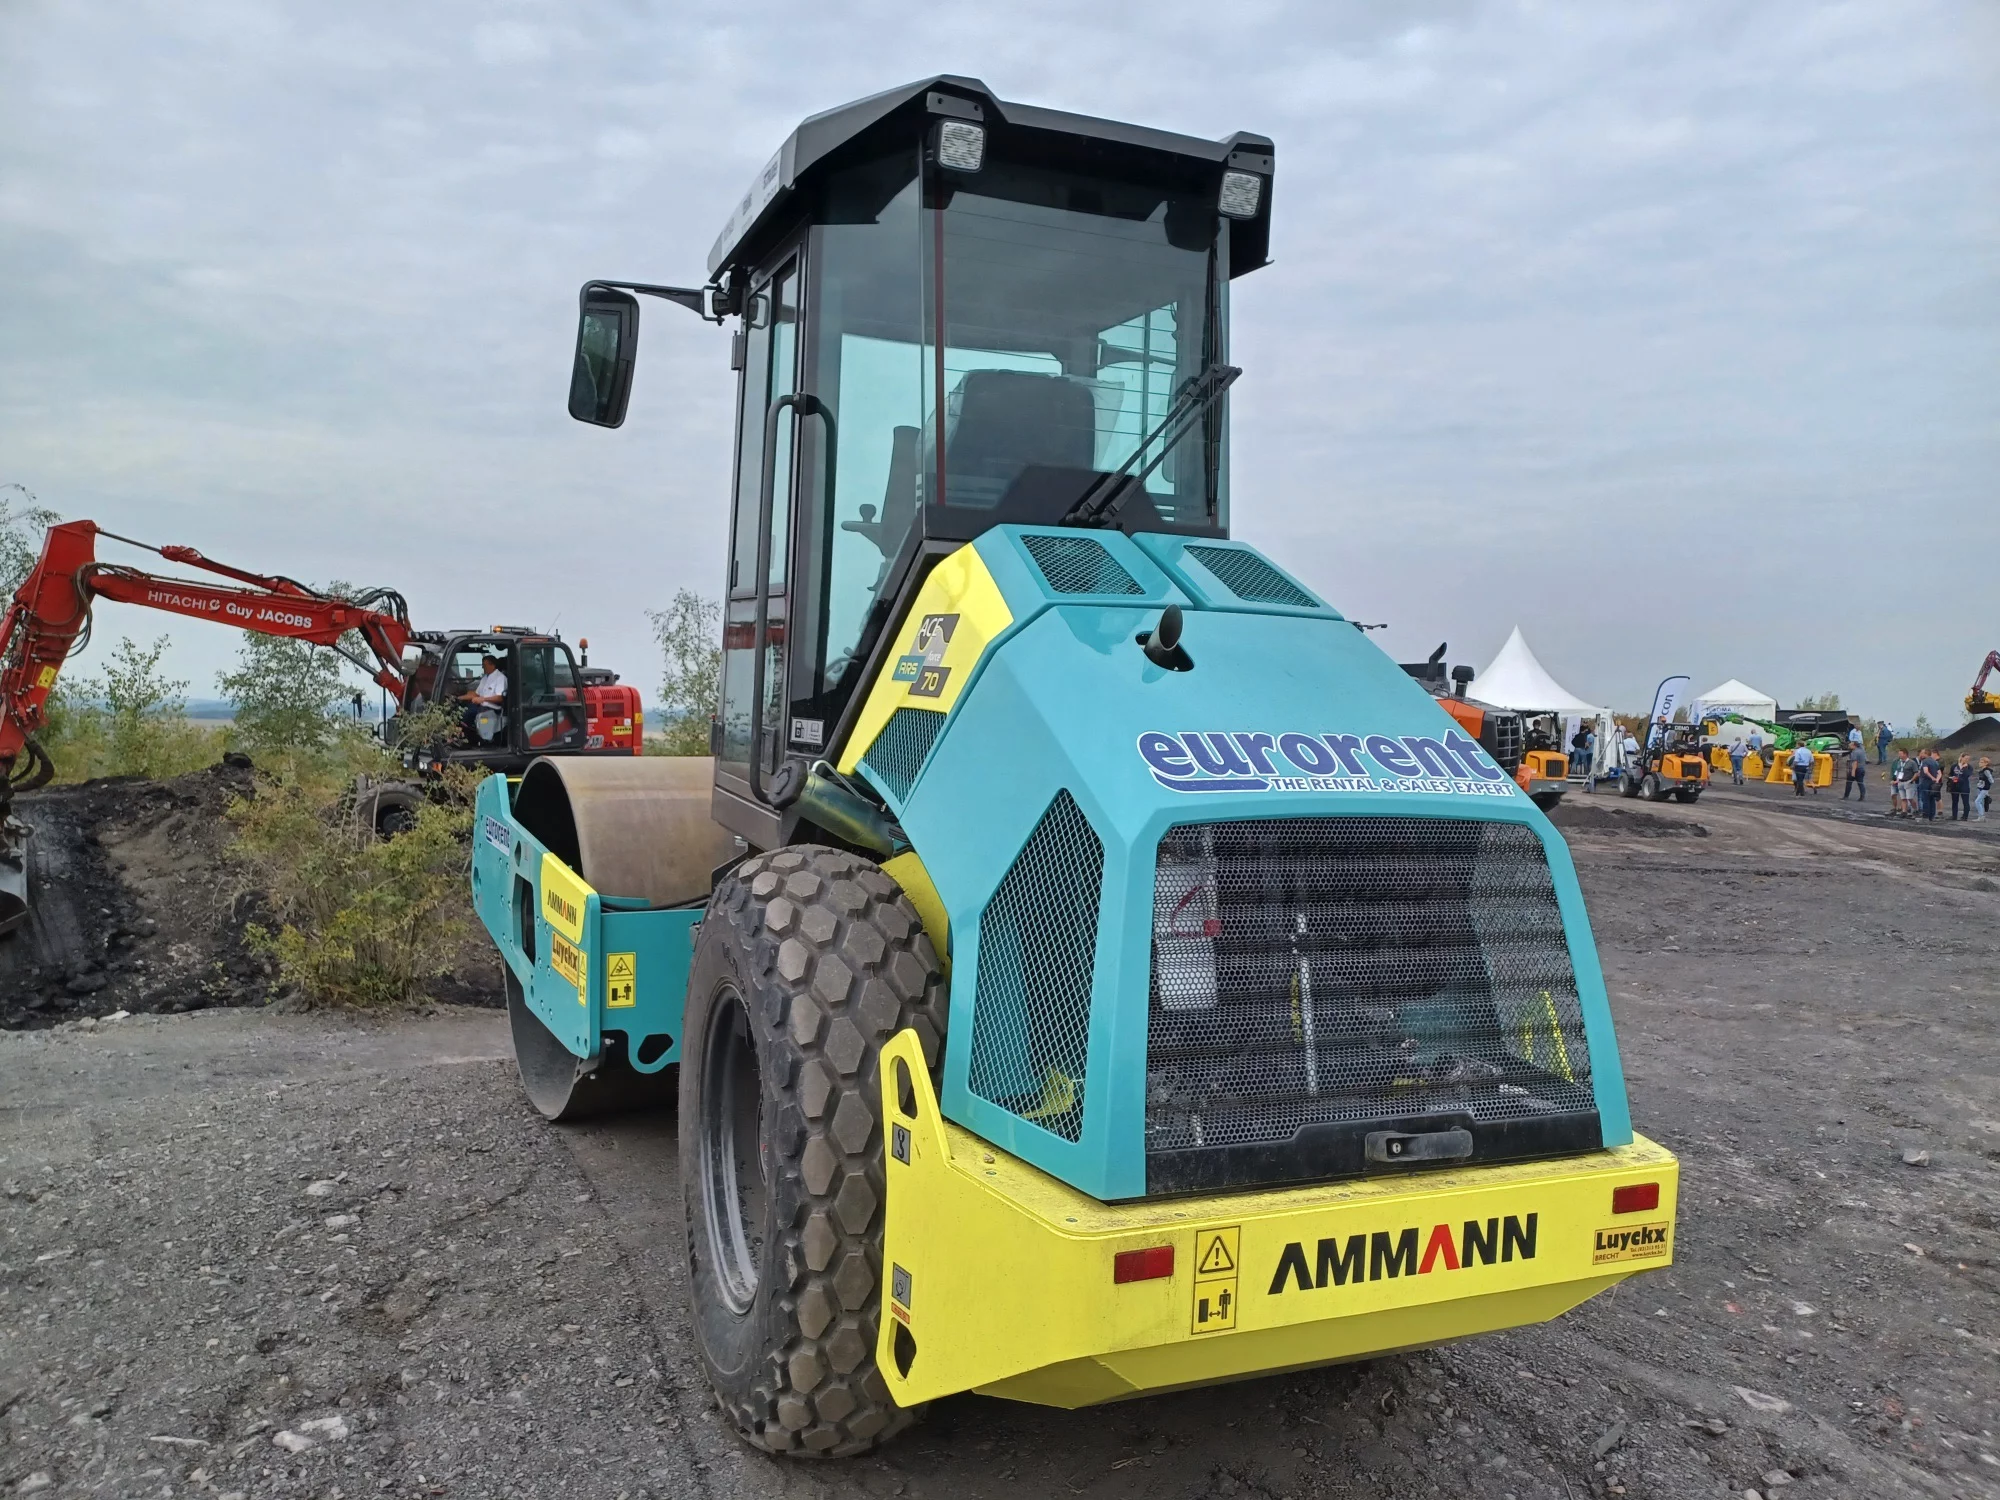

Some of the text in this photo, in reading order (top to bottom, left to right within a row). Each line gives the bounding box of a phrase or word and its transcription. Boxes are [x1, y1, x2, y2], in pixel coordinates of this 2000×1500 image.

[148, 590, 206, 610] HITACHI
[226, 602, 313, 629] Guy JACOBS
[918, 617, 944, 637] ACE
[899, 661, 918, 675] ARS
[920, 671, 939, 691] 70
[1137, 729, 1504, 783] eurorent
[1272, 777, 1515, 797] THE RENTAL & SALES EXPERT
[486, 817, 510, 848] eurorent
[547, 889, 577, 926] AMMANN
[553, 932, 577, 972] Luyckx
[1596, 1227, 1667, 1251] Luyckx
[1267, 1212, 1538, 1296] AMMANN
[1595, 1253, 1619, 1261] BRECHT
